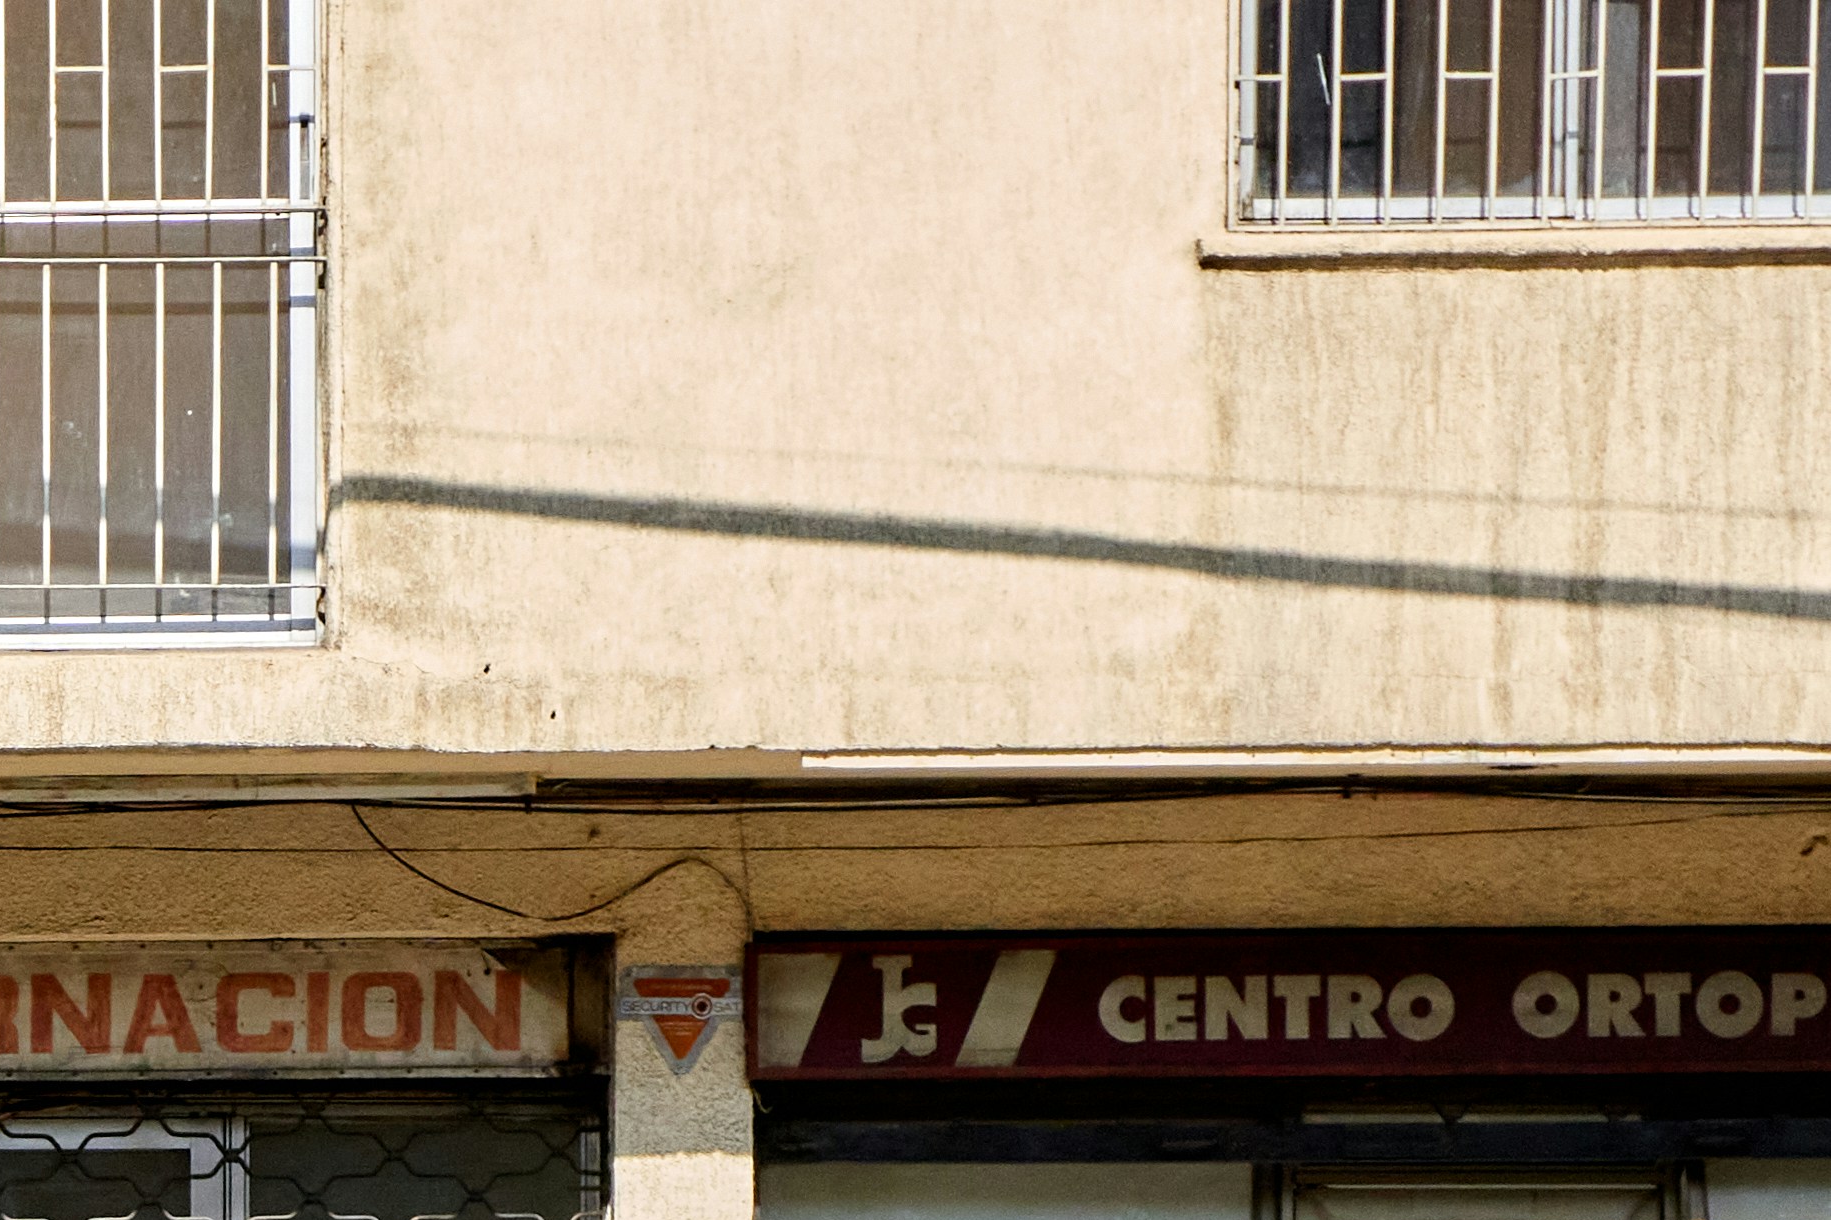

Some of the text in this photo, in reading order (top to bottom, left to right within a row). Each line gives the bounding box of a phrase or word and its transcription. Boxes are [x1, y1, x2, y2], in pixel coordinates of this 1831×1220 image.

[622, 1000, 741, 1013] SECURITY SAT
[1097, 970, 1829, 1044] CENTRO ORTOP
